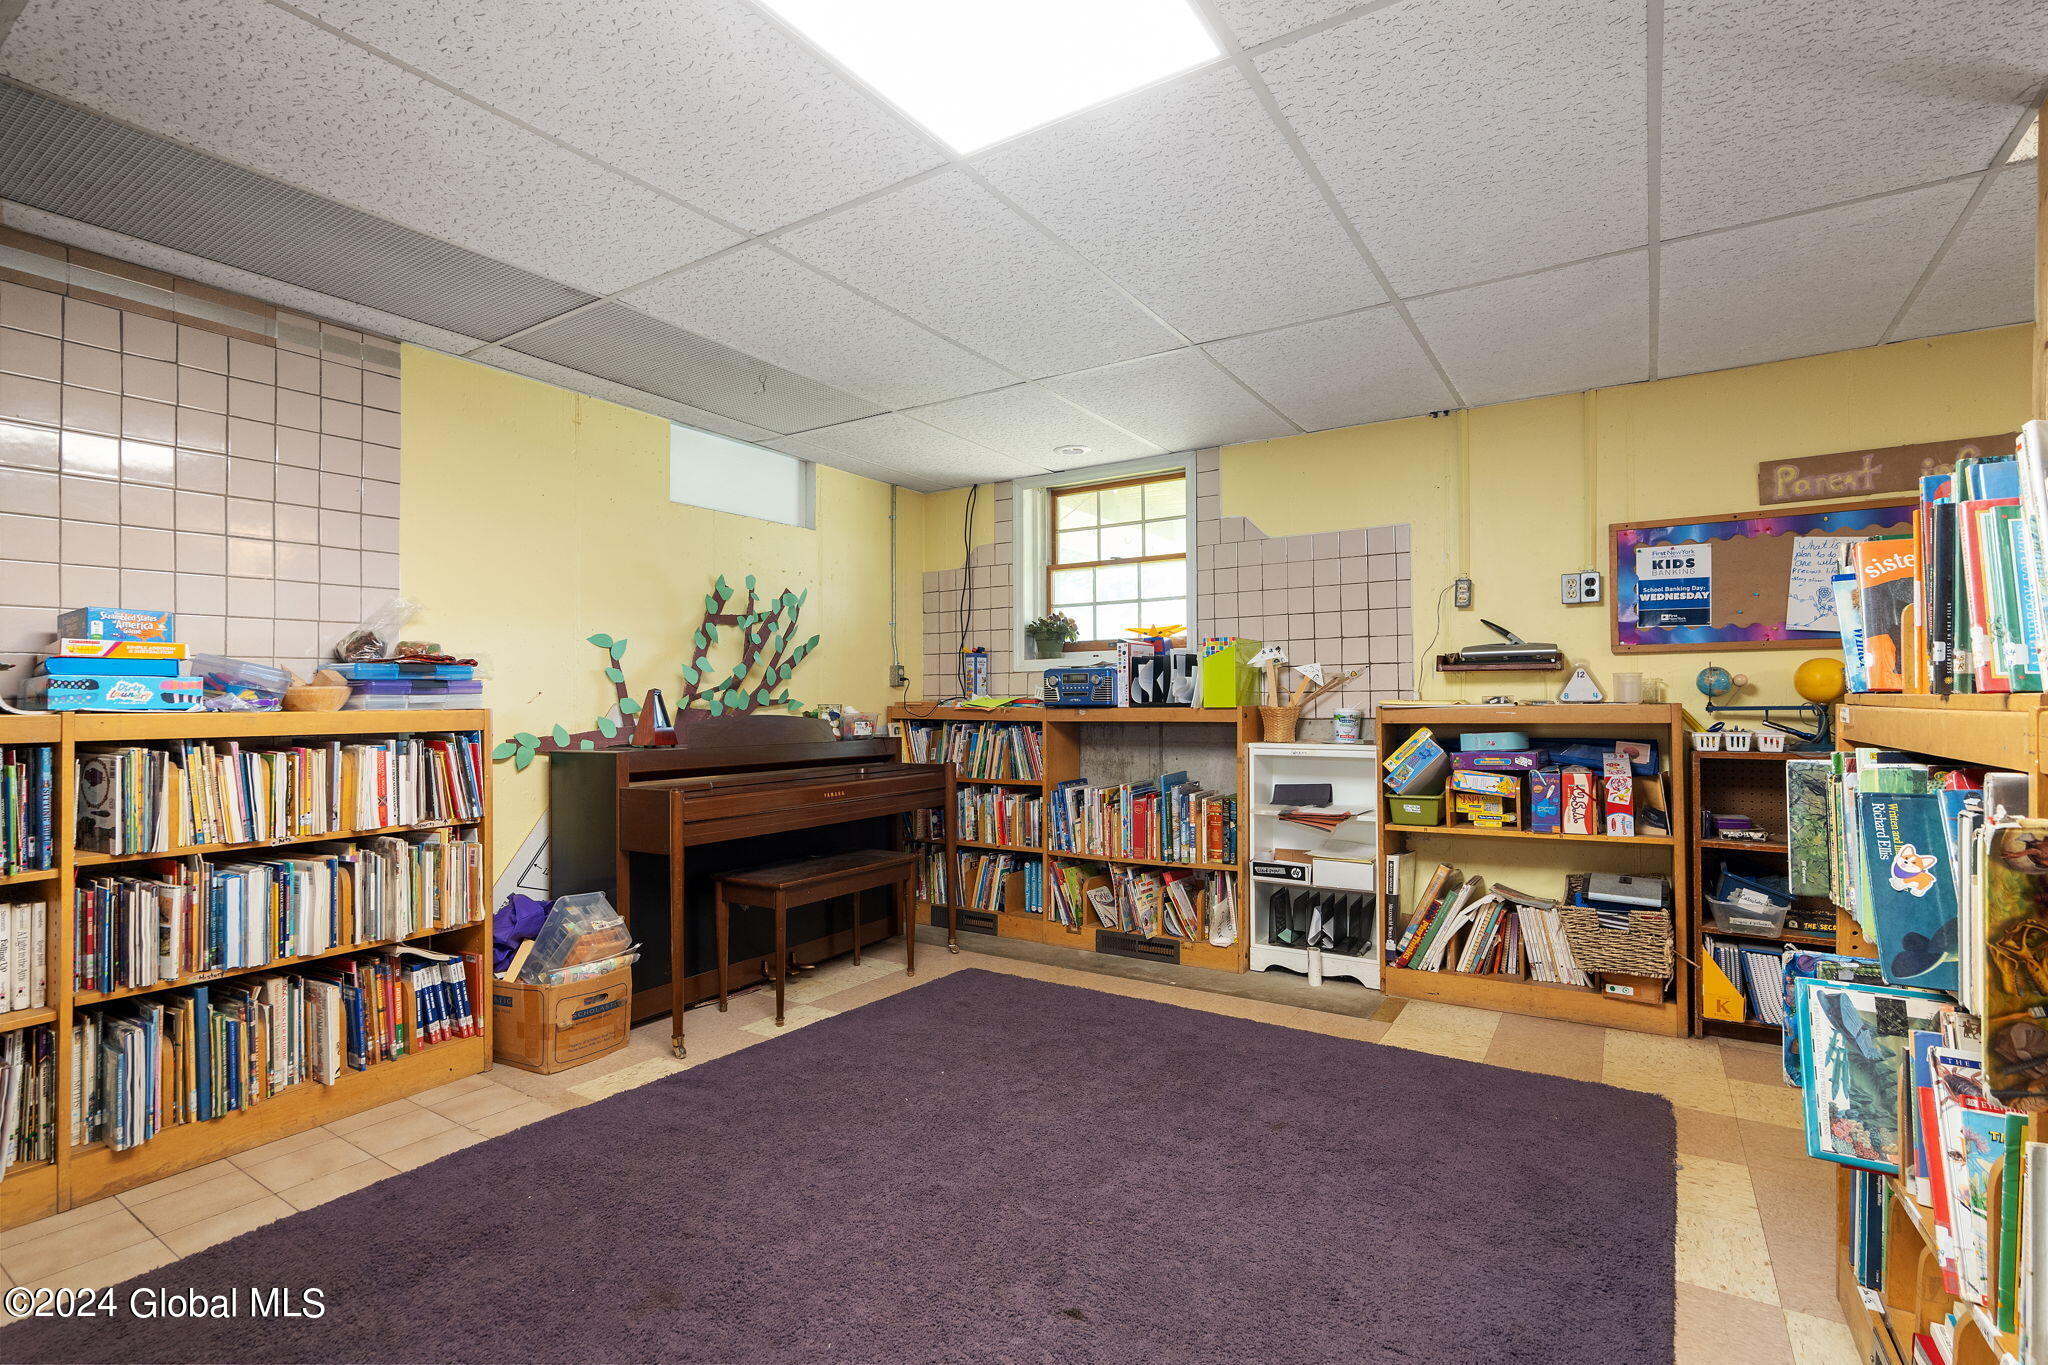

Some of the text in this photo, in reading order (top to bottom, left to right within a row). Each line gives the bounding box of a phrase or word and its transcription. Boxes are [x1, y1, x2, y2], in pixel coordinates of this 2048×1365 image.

[1774, 453, 1884, 499] Parent
[1652, 558, 1696, 569] KIDS
[1864, 553, 1915, 579] siste
[1651, 568, 1696, 576] BANKING
[1639, 592, 1710, 602] WEDNESDAY
[100, 611, 158, 622] Scrambled States
[115, 620, 154, 630] America
[1576, 671, 1586, 679] 12
[1887, 803, 1899, 830] Written
[1871, 802, 1892, 860] Richard Ellis
[1891, 830, 1904, 844] and
[1803, 922, 1818, 930] THE
[15, 937, 27, 952] Light
[198, 971, 225, 981] History
[572, 999, 627, 1020] SCHOLASTIC
[1716, 999, 1731, 1015] K
[1946, 1058, 1970, 1067] THE
